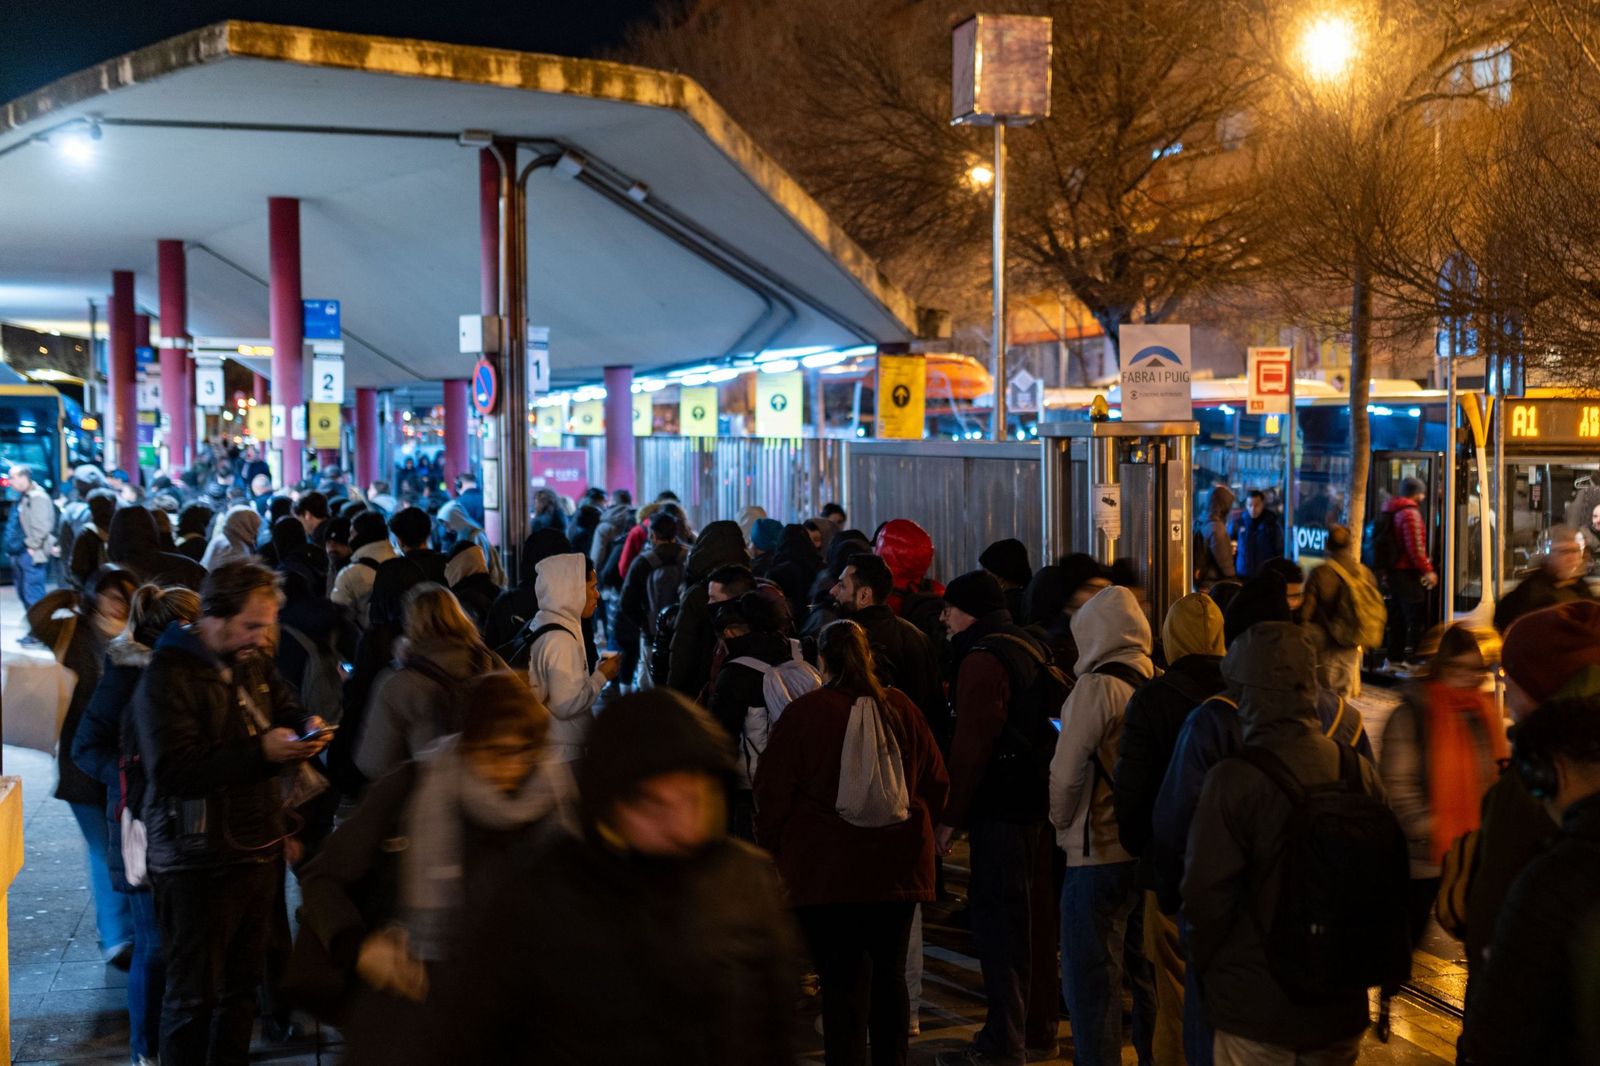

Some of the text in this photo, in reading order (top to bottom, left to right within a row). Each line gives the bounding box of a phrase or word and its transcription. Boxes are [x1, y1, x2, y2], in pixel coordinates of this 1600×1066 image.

[532, 359, 541, 380] 1
[1121, 371, 1190, 383] FABRA I PUIG
[205, 380, 215, 395] 3
[323, 373, 334, 391] 2
[1512, 405, 1538, 437] A1
